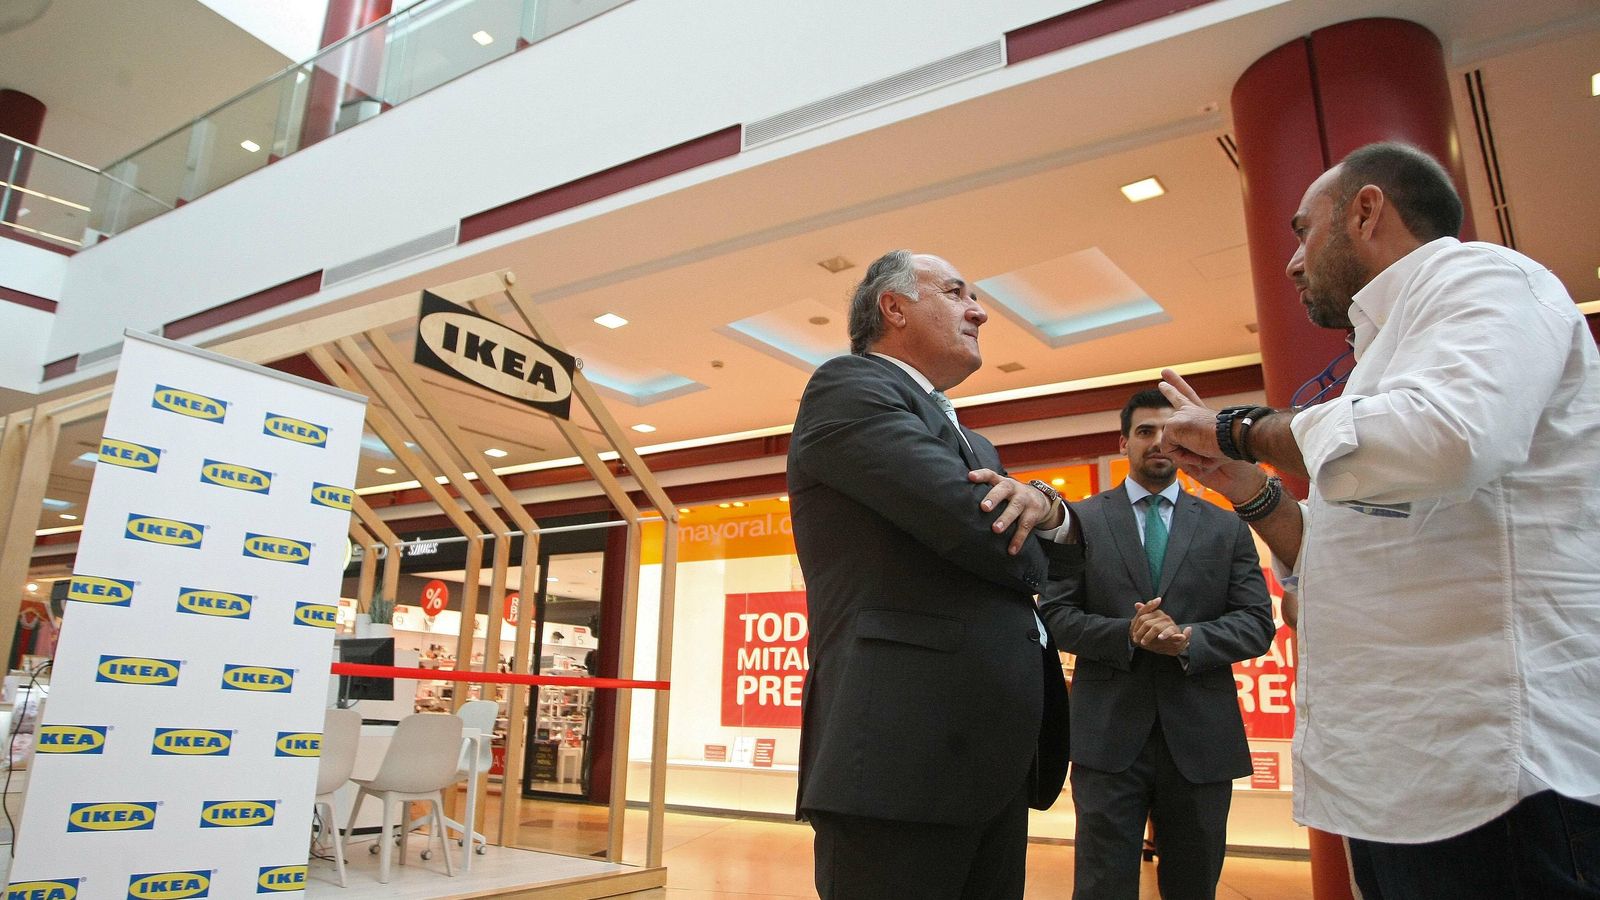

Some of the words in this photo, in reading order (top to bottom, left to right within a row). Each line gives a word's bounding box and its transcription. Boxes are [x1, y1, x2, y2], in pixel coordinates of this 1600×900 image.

[442, 321, 557, 394] IKEA
[164, 394, 217, 414] IKEA
[273, 421, 319, 439] IKEA
[101, 445, 150, 463] KEA
[211, 468, 262, 485] IKEA
[320, 490, 351, 504] IKE
[136, 523, 194, 540] IKEA
[678, 512, 793, 545] mayoral.c
[253, 542, 302, 557] IKEA
[71, 582, 123, 598] KEA
[188, 596, 243, 610] IKEA
[304, 610, 335, 621] IKE
[739, 612, 808, 643] TOD
[737, 647, 809, 671] MITA
[109, 664, 170, 678] IKEA
[232, 672, 285, 685] IKEA
[736, 675, 803, 706] PRE
[40, 733, 95, 746] KEA
[164, 736, 222, 748] IKEA
[285, 740, 320, 750] IKE
[81, 811, 146, 823] IKEA
[212, 808, 267, 819] IKEA
[267, 873, 304, 885] IKE
[8, 888, 66, 900] KEA
[139, 880, 201, 894] IKEA
